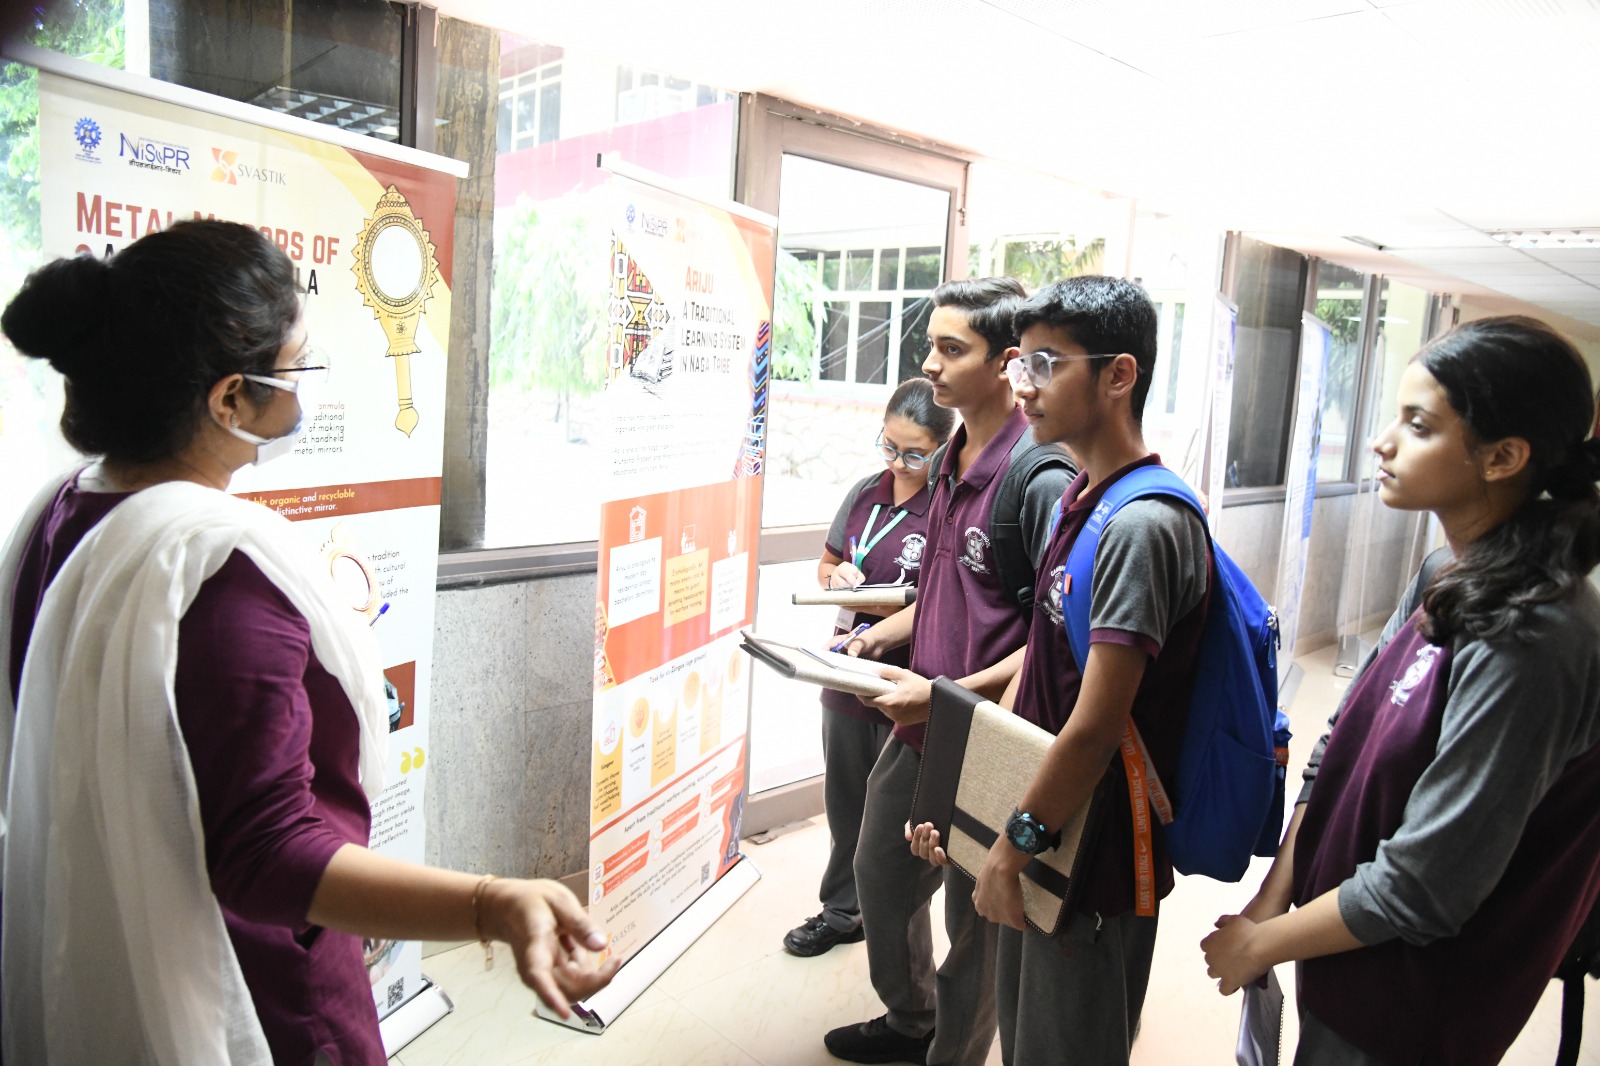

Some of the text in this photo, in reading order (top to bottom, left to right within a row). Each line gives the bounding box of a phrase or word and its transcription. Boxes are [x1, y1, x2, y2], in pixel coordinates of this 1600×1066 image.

[238, 163, 286, 186] SVASTIK
[313, 235, 340, 265] OF
[685, 266, 715, 294] ARIJU
[683, 300, 735, 326] A TRADITIONAL
[681, 327, 746, 351] LEARNING SYSTEM
[680, 354, 731, 374] IN NAGA TRIBE
[308, 422, 345, 434] of making
[311, 433, 345, 443] handheld
[294, 445, 316, 455] metal
[269, 496, 301, 506] organic
[302, 492, 317, 503] and
[318, 488, 356, 501] recyclable
[314, 503, 338, 512] mirror.
[372, 550, 400, 561] tradition
[382, 561, 406, 573] cultural
[1122, 737, 1136, 755] LEAVE
[1132, 778, 1147, 833] LEAVE YOUR TRACE
[1139, 854, 1148, 874] TRACE
[1140, 890, 1150, 909] LEAVE
